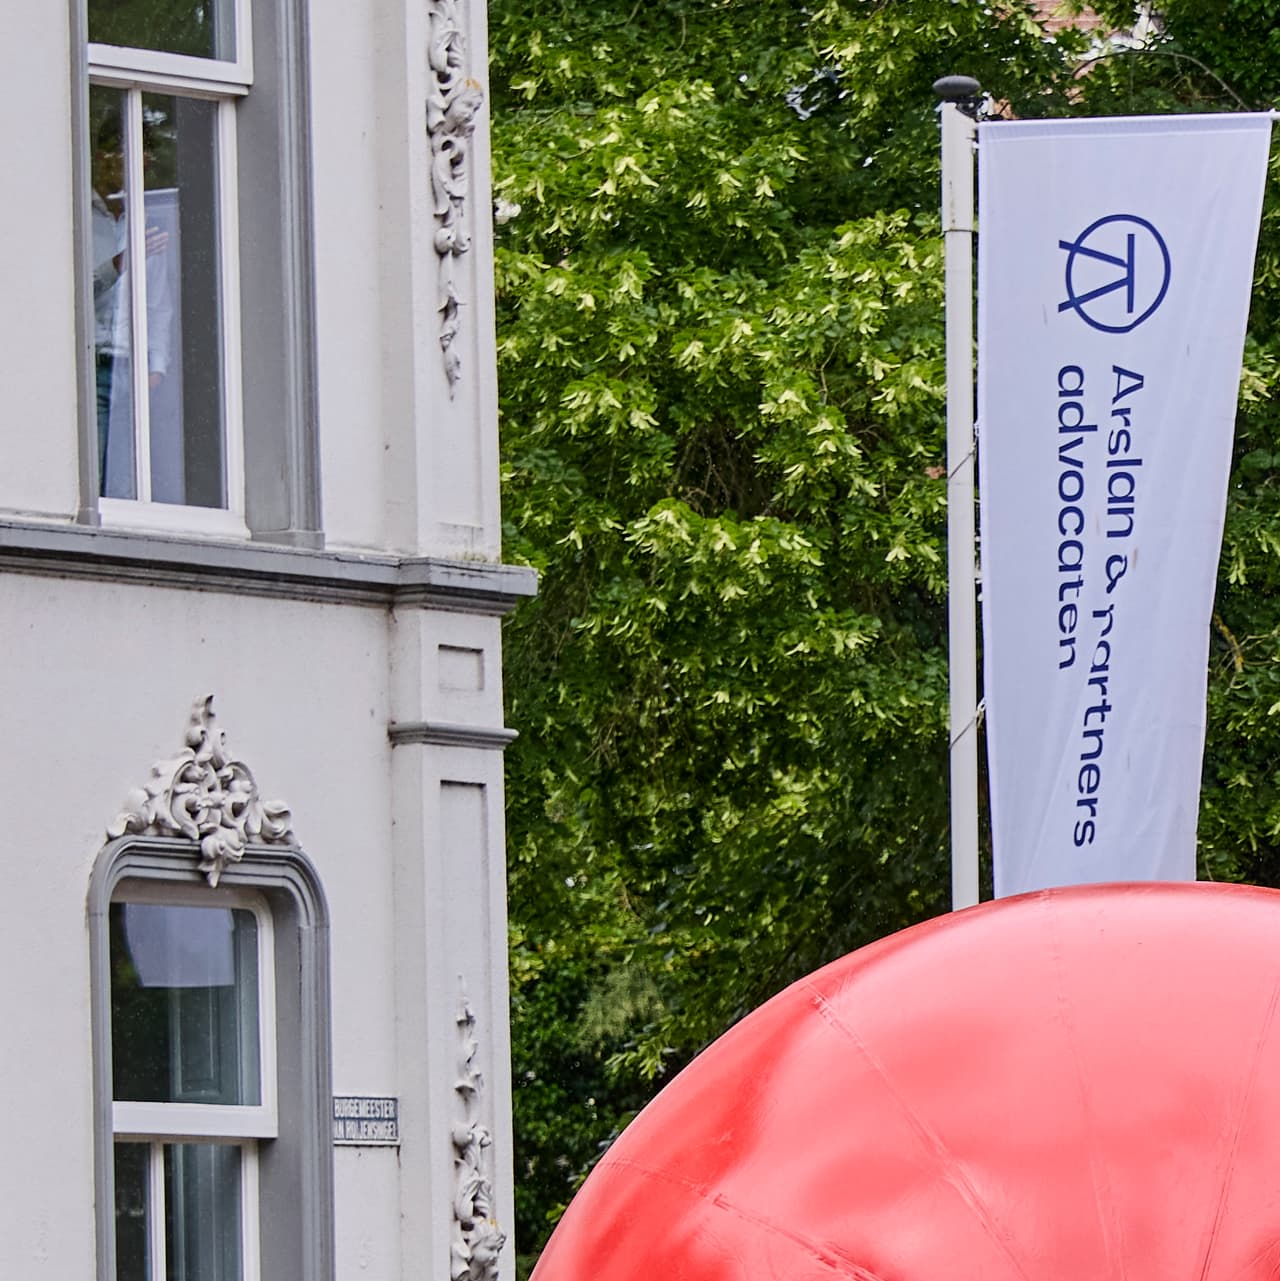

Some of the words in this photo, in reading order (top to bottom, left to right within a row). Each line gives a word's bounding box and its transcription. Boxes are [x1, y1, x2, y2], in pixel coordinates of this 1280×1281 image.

[1056, 363, 1099, 670] advocaten
[1105, 363, 1145, 539] Arslan
[1104, 553, 1129, 595] &
[1072, 602, 1117, 849] partners
